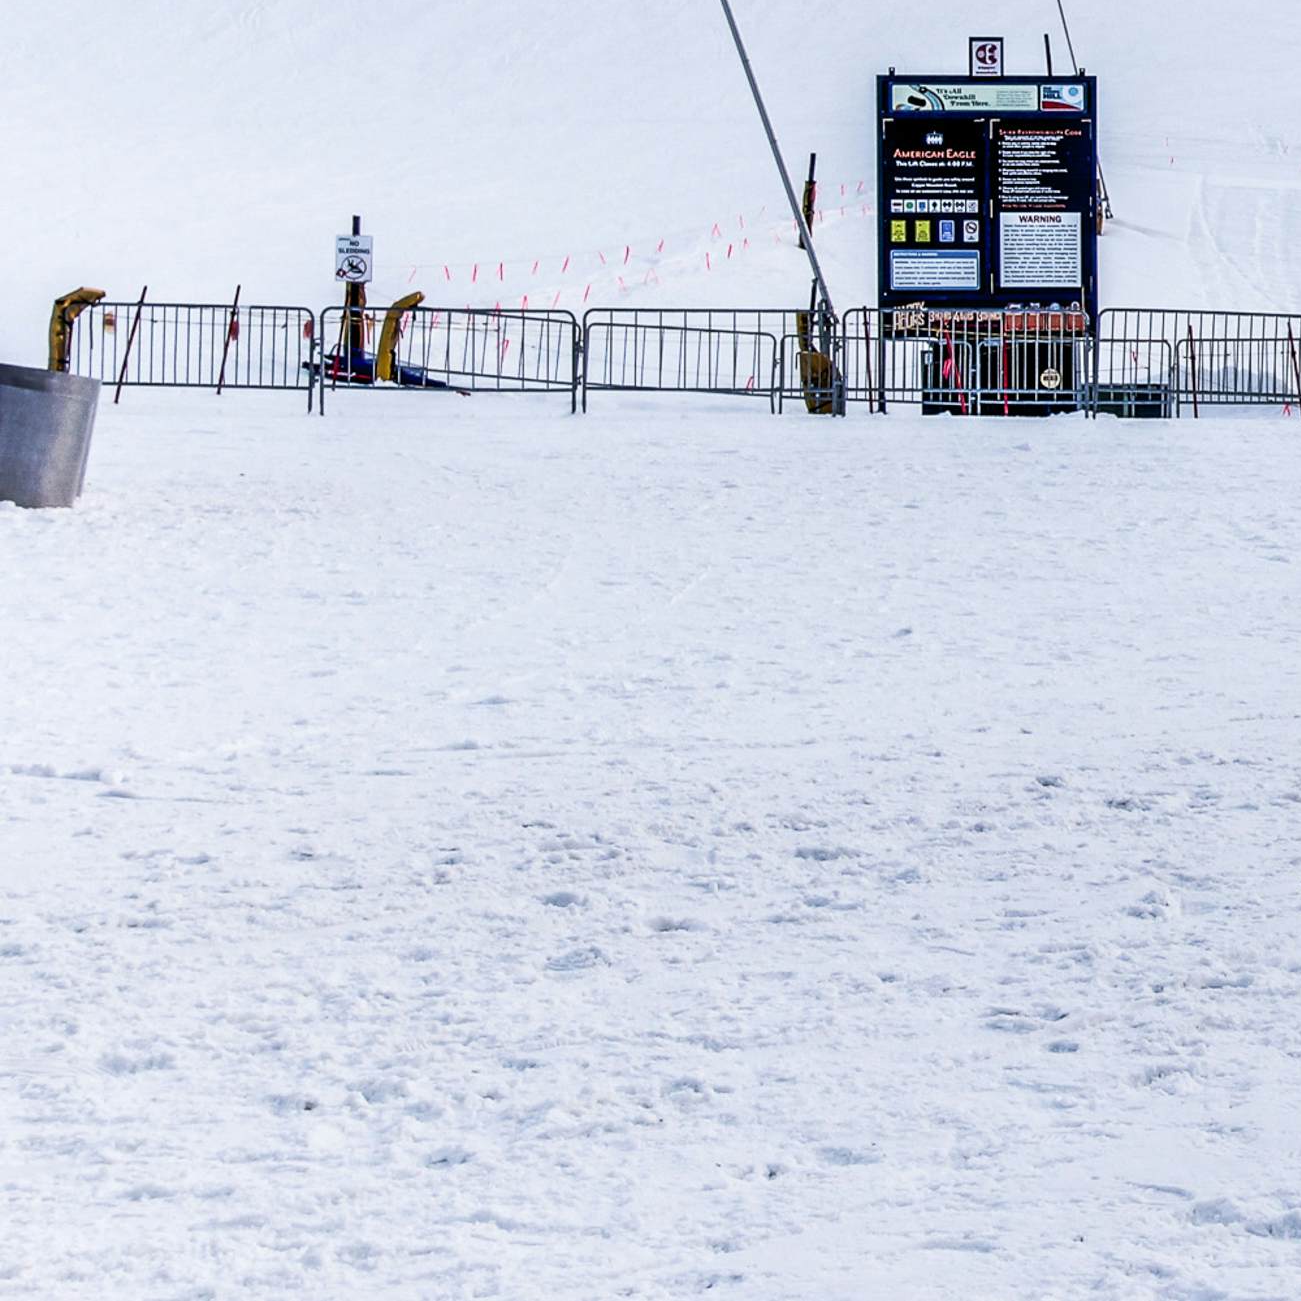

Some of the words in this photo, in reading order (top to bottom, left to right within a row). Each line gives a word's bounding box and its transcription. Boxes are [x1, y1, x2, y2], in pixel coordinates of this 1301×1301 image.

[893, 148, 944, 159] AMERICAN
[946, 148, 976, 159] EAGLE
[1018, 214, 1062, 223] WARNING
